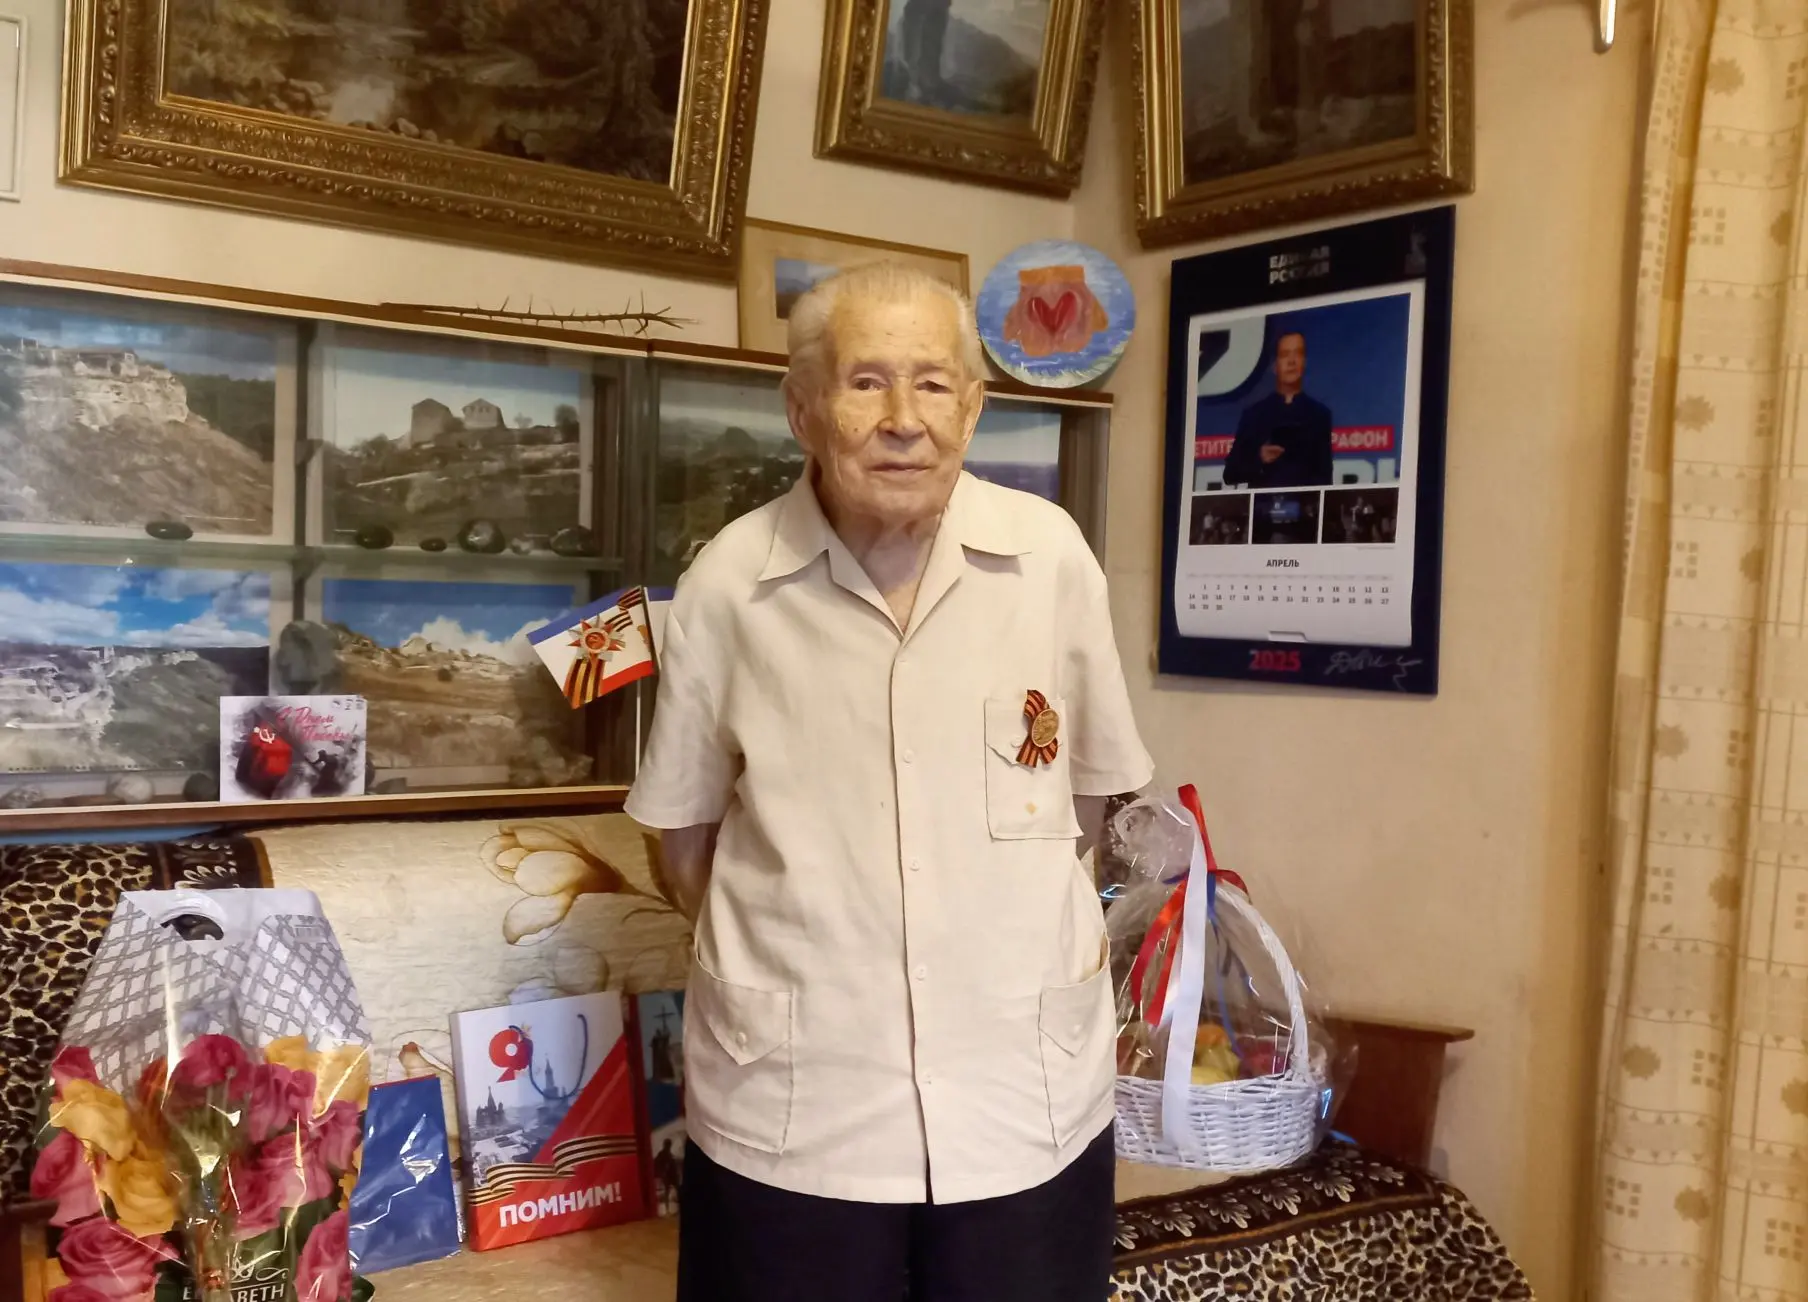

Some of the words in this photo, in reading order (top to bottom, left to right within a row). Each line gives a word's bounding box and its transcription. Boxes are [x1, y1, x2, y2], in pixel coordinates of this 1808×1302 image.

[1269, 245, 1330, 269] ЕДИАЯ
[1266, 559, 1300, 568] АПРЕЛЬ
[1249, 649, 1302, 672] 2025
[499, 1182, 623, 1228] ПОМНИМ!
[183, 1283, 286, 1302] EBETH
